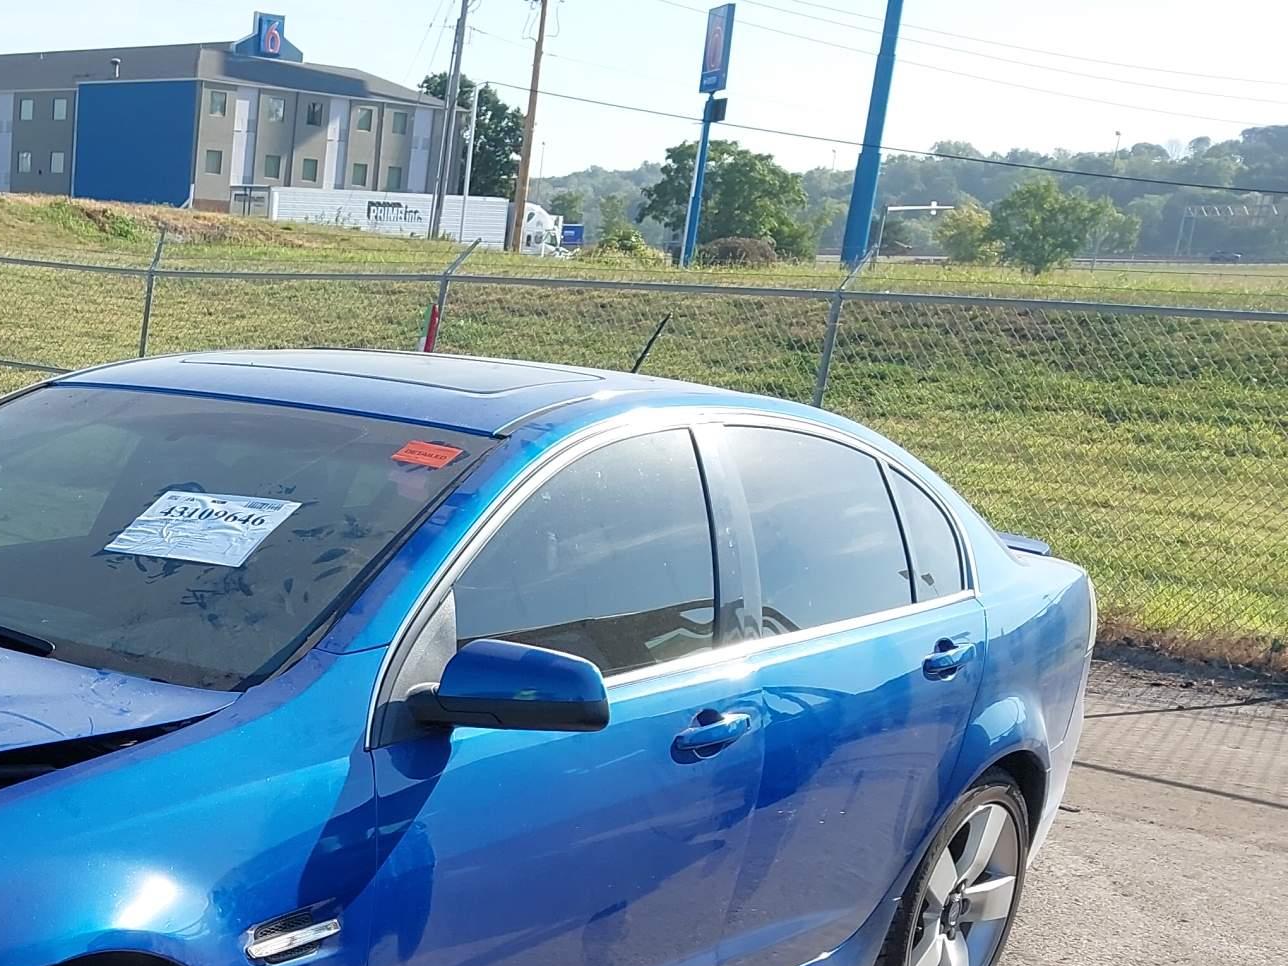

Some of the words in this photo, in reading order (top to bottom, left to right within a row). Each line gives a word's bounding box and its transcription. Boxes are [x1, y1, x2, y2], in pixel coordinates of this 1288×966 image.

[264, 20, 281, 54] 6
[405, 448, 447, 460] DETAILED
[160, 504, 268, 526] 43109646
